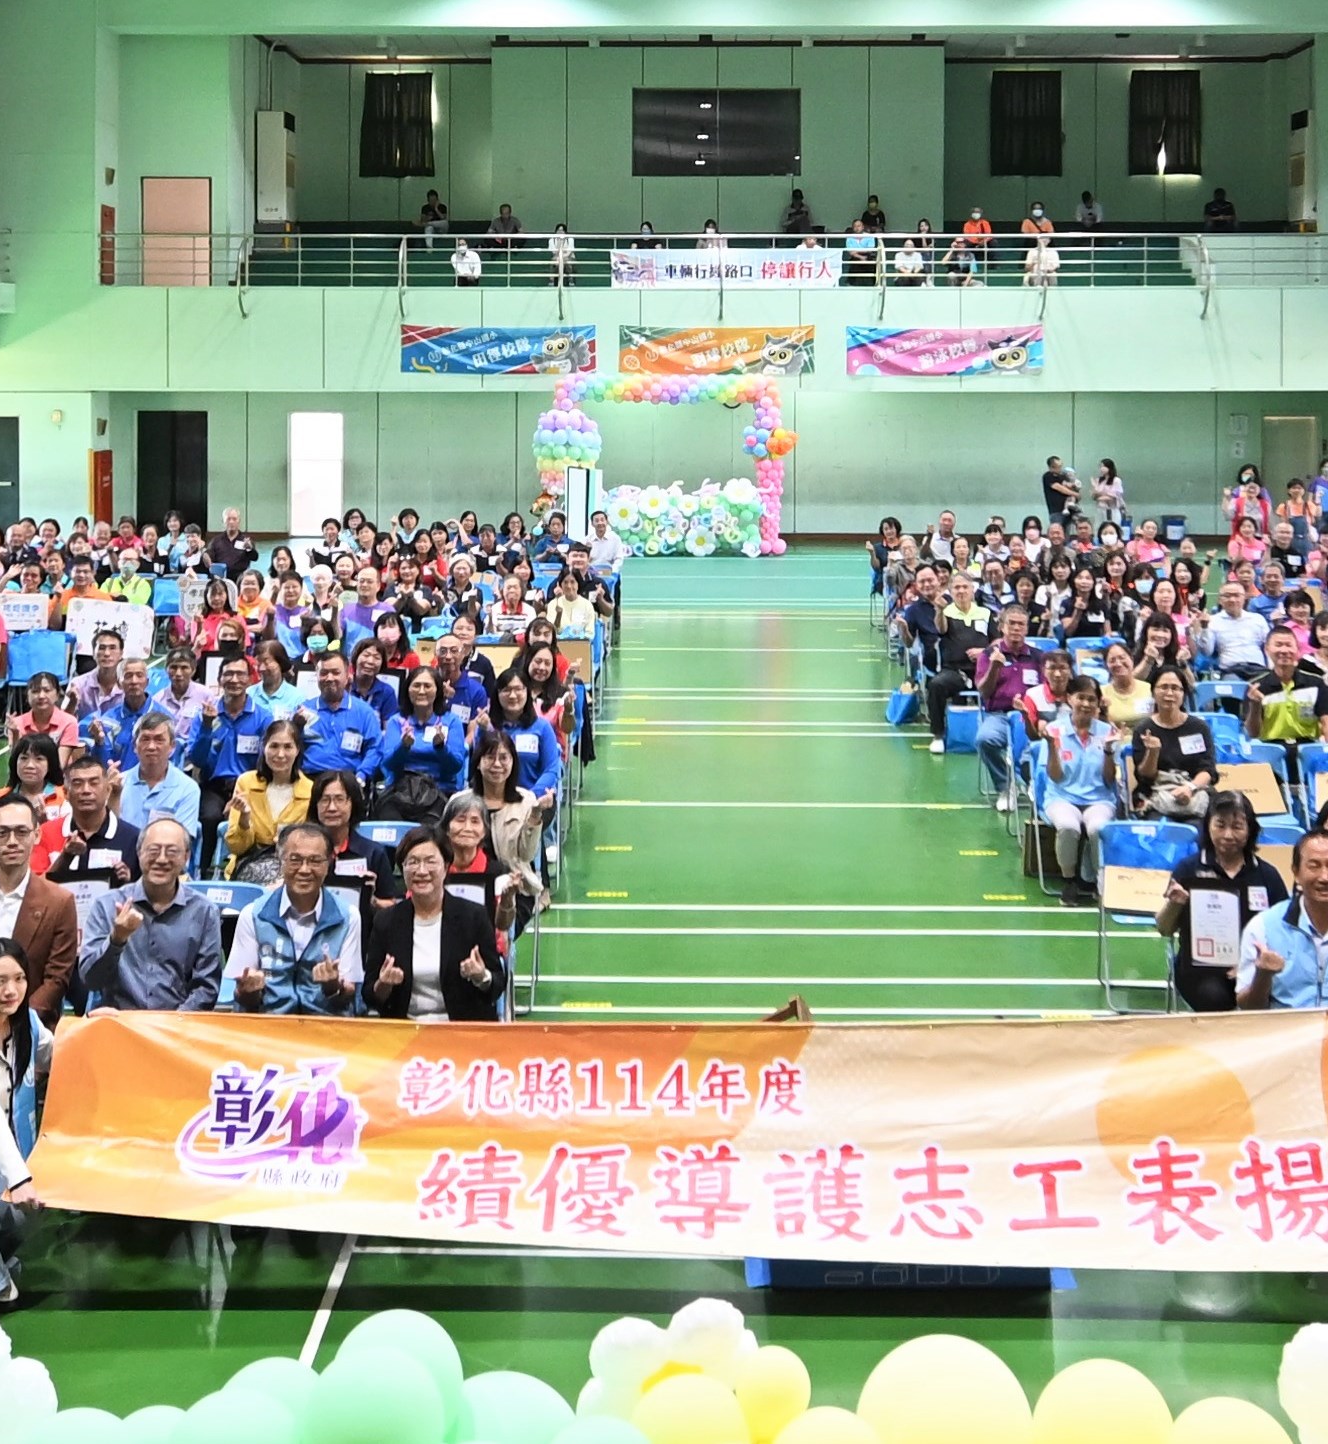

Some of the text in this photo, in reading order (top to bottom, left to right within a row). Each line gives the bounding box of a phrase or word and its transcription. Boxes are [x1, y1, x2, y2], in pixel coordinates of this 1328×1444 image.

[760, 260, 832, 280] 停讓行人
[210, 1066, 354, 1165] 彰化
[401, 1061, 806, 1117] 彰化縣114年度
